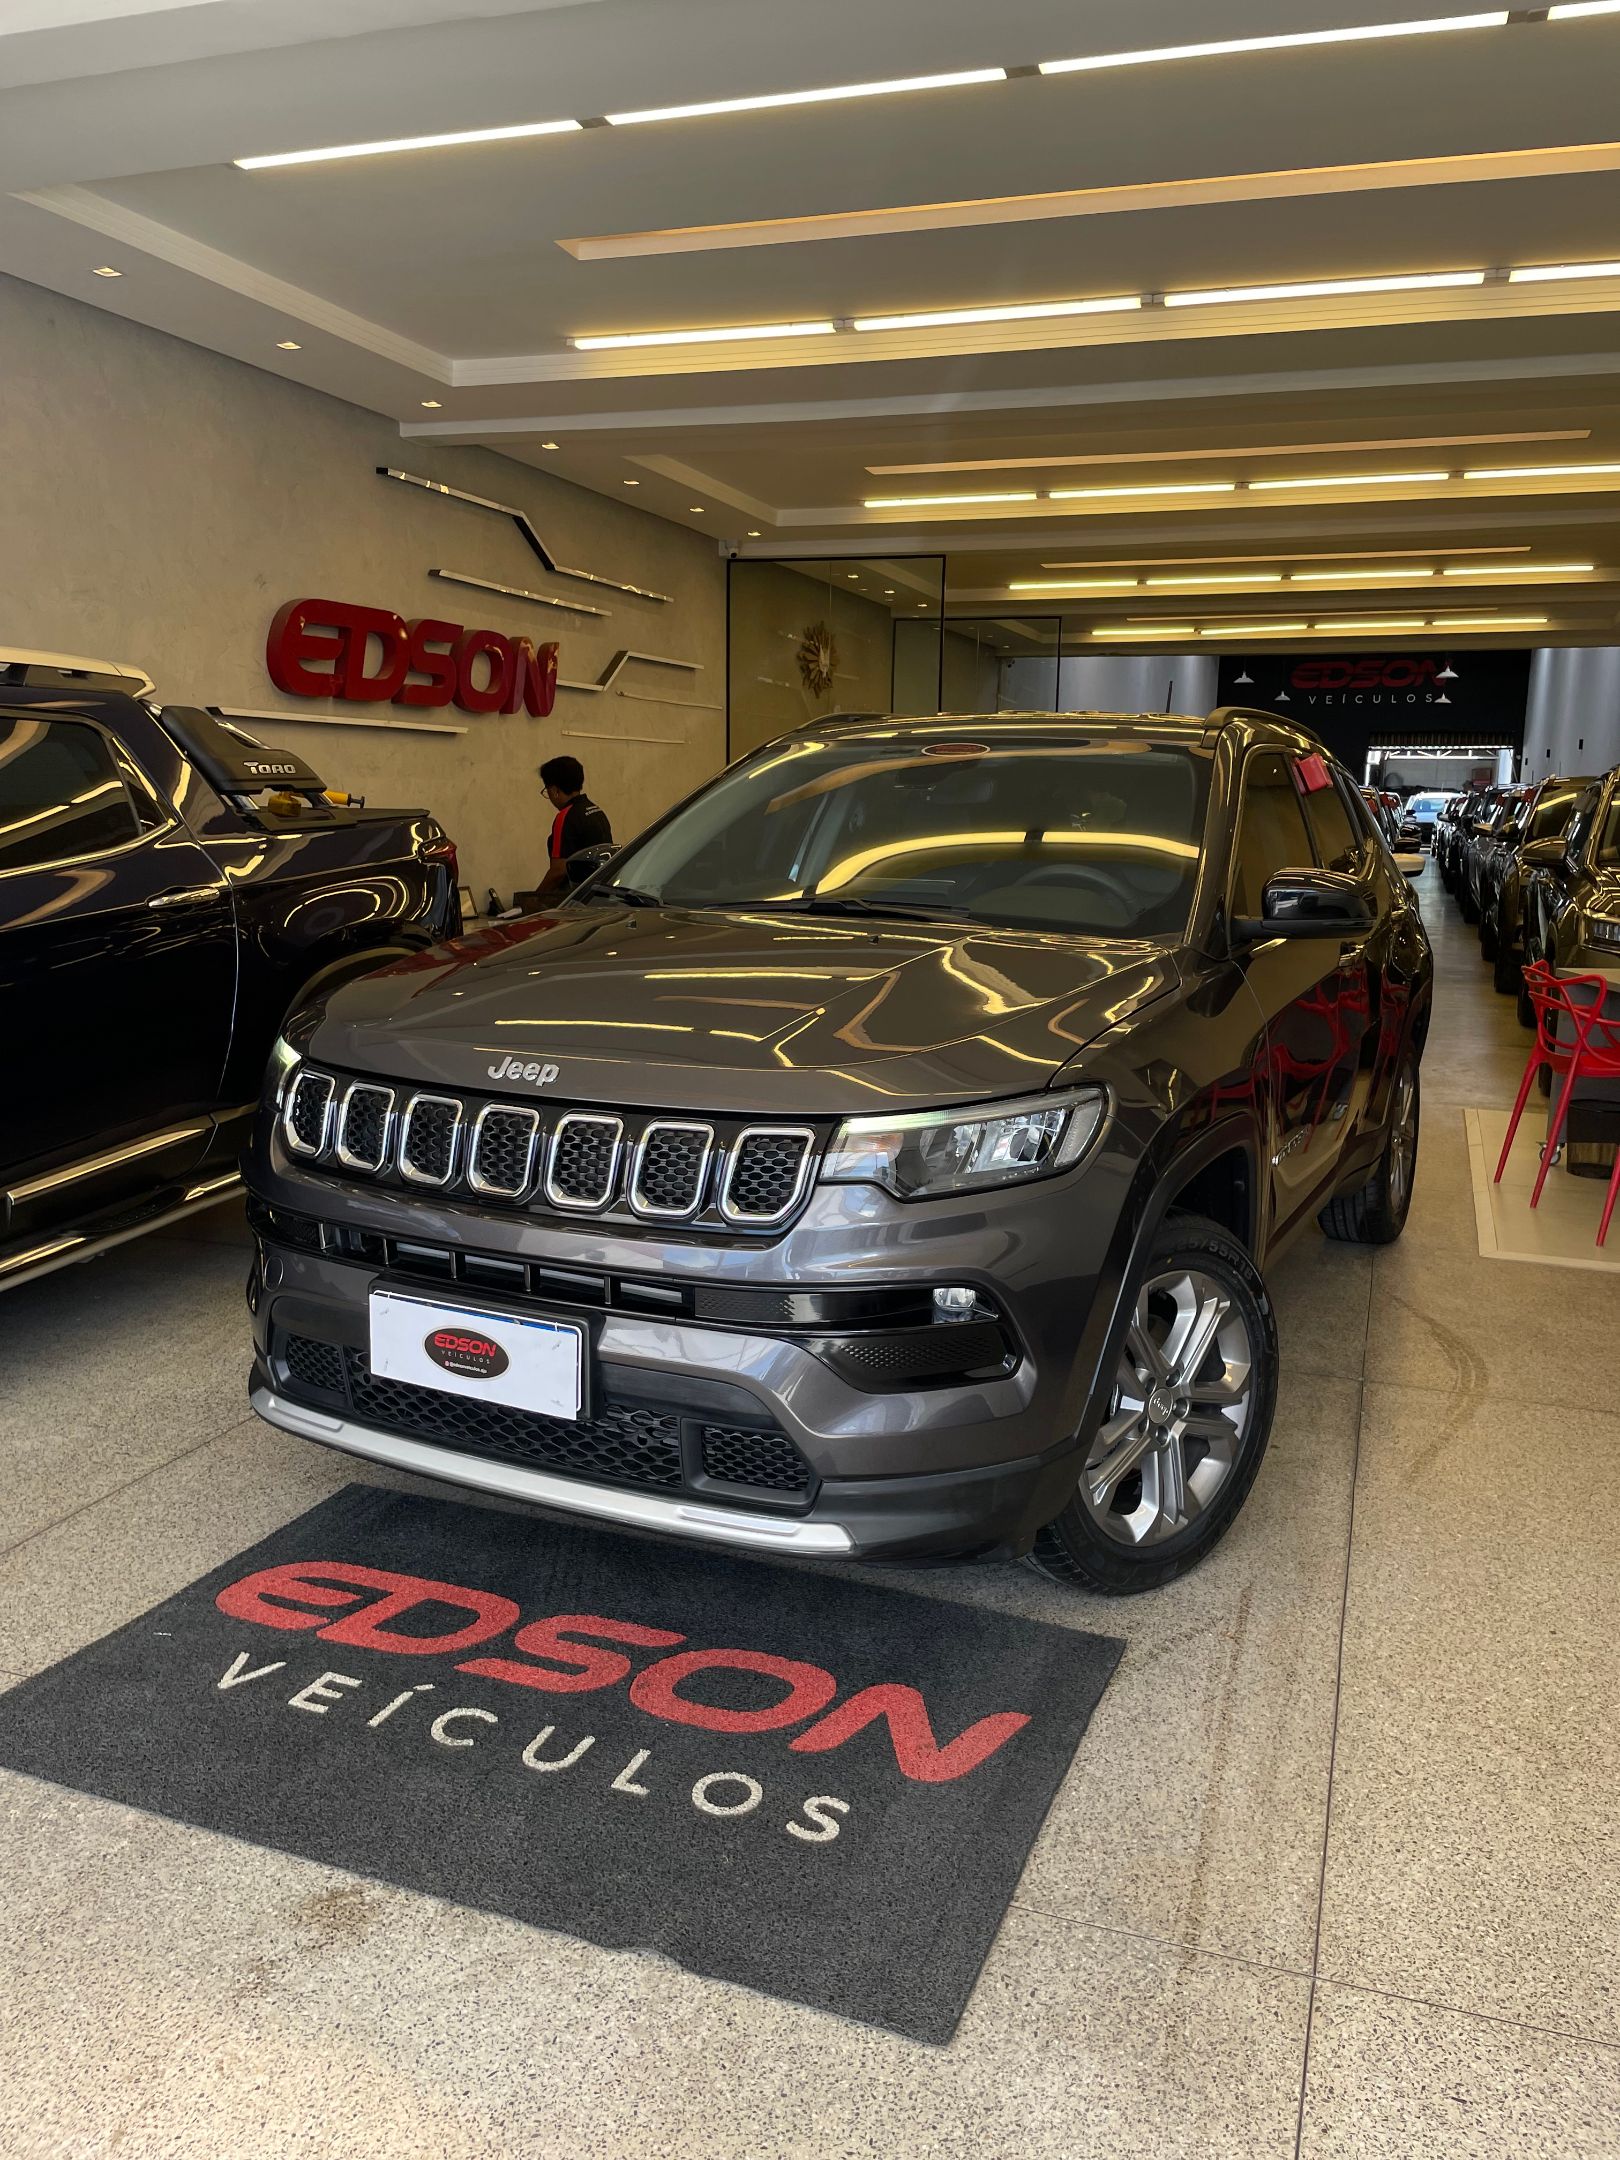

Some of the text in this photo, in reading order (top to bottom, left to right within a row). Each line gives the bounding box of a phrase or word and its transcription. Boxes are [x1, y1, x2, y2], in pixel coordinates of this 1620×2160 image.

[266, 598, 560, 717] EDSON
[1290, 659, 1453, 689] EDSON
[243, 761, 297, 775] TORO
[487, 1056, 560, 1087] Jeep
[433, 1332, 497, 1357] EDSON
[215, 1560, 1031, 1782] EDSON
[216, 1650, 851, 1843] VEÍCULOS
